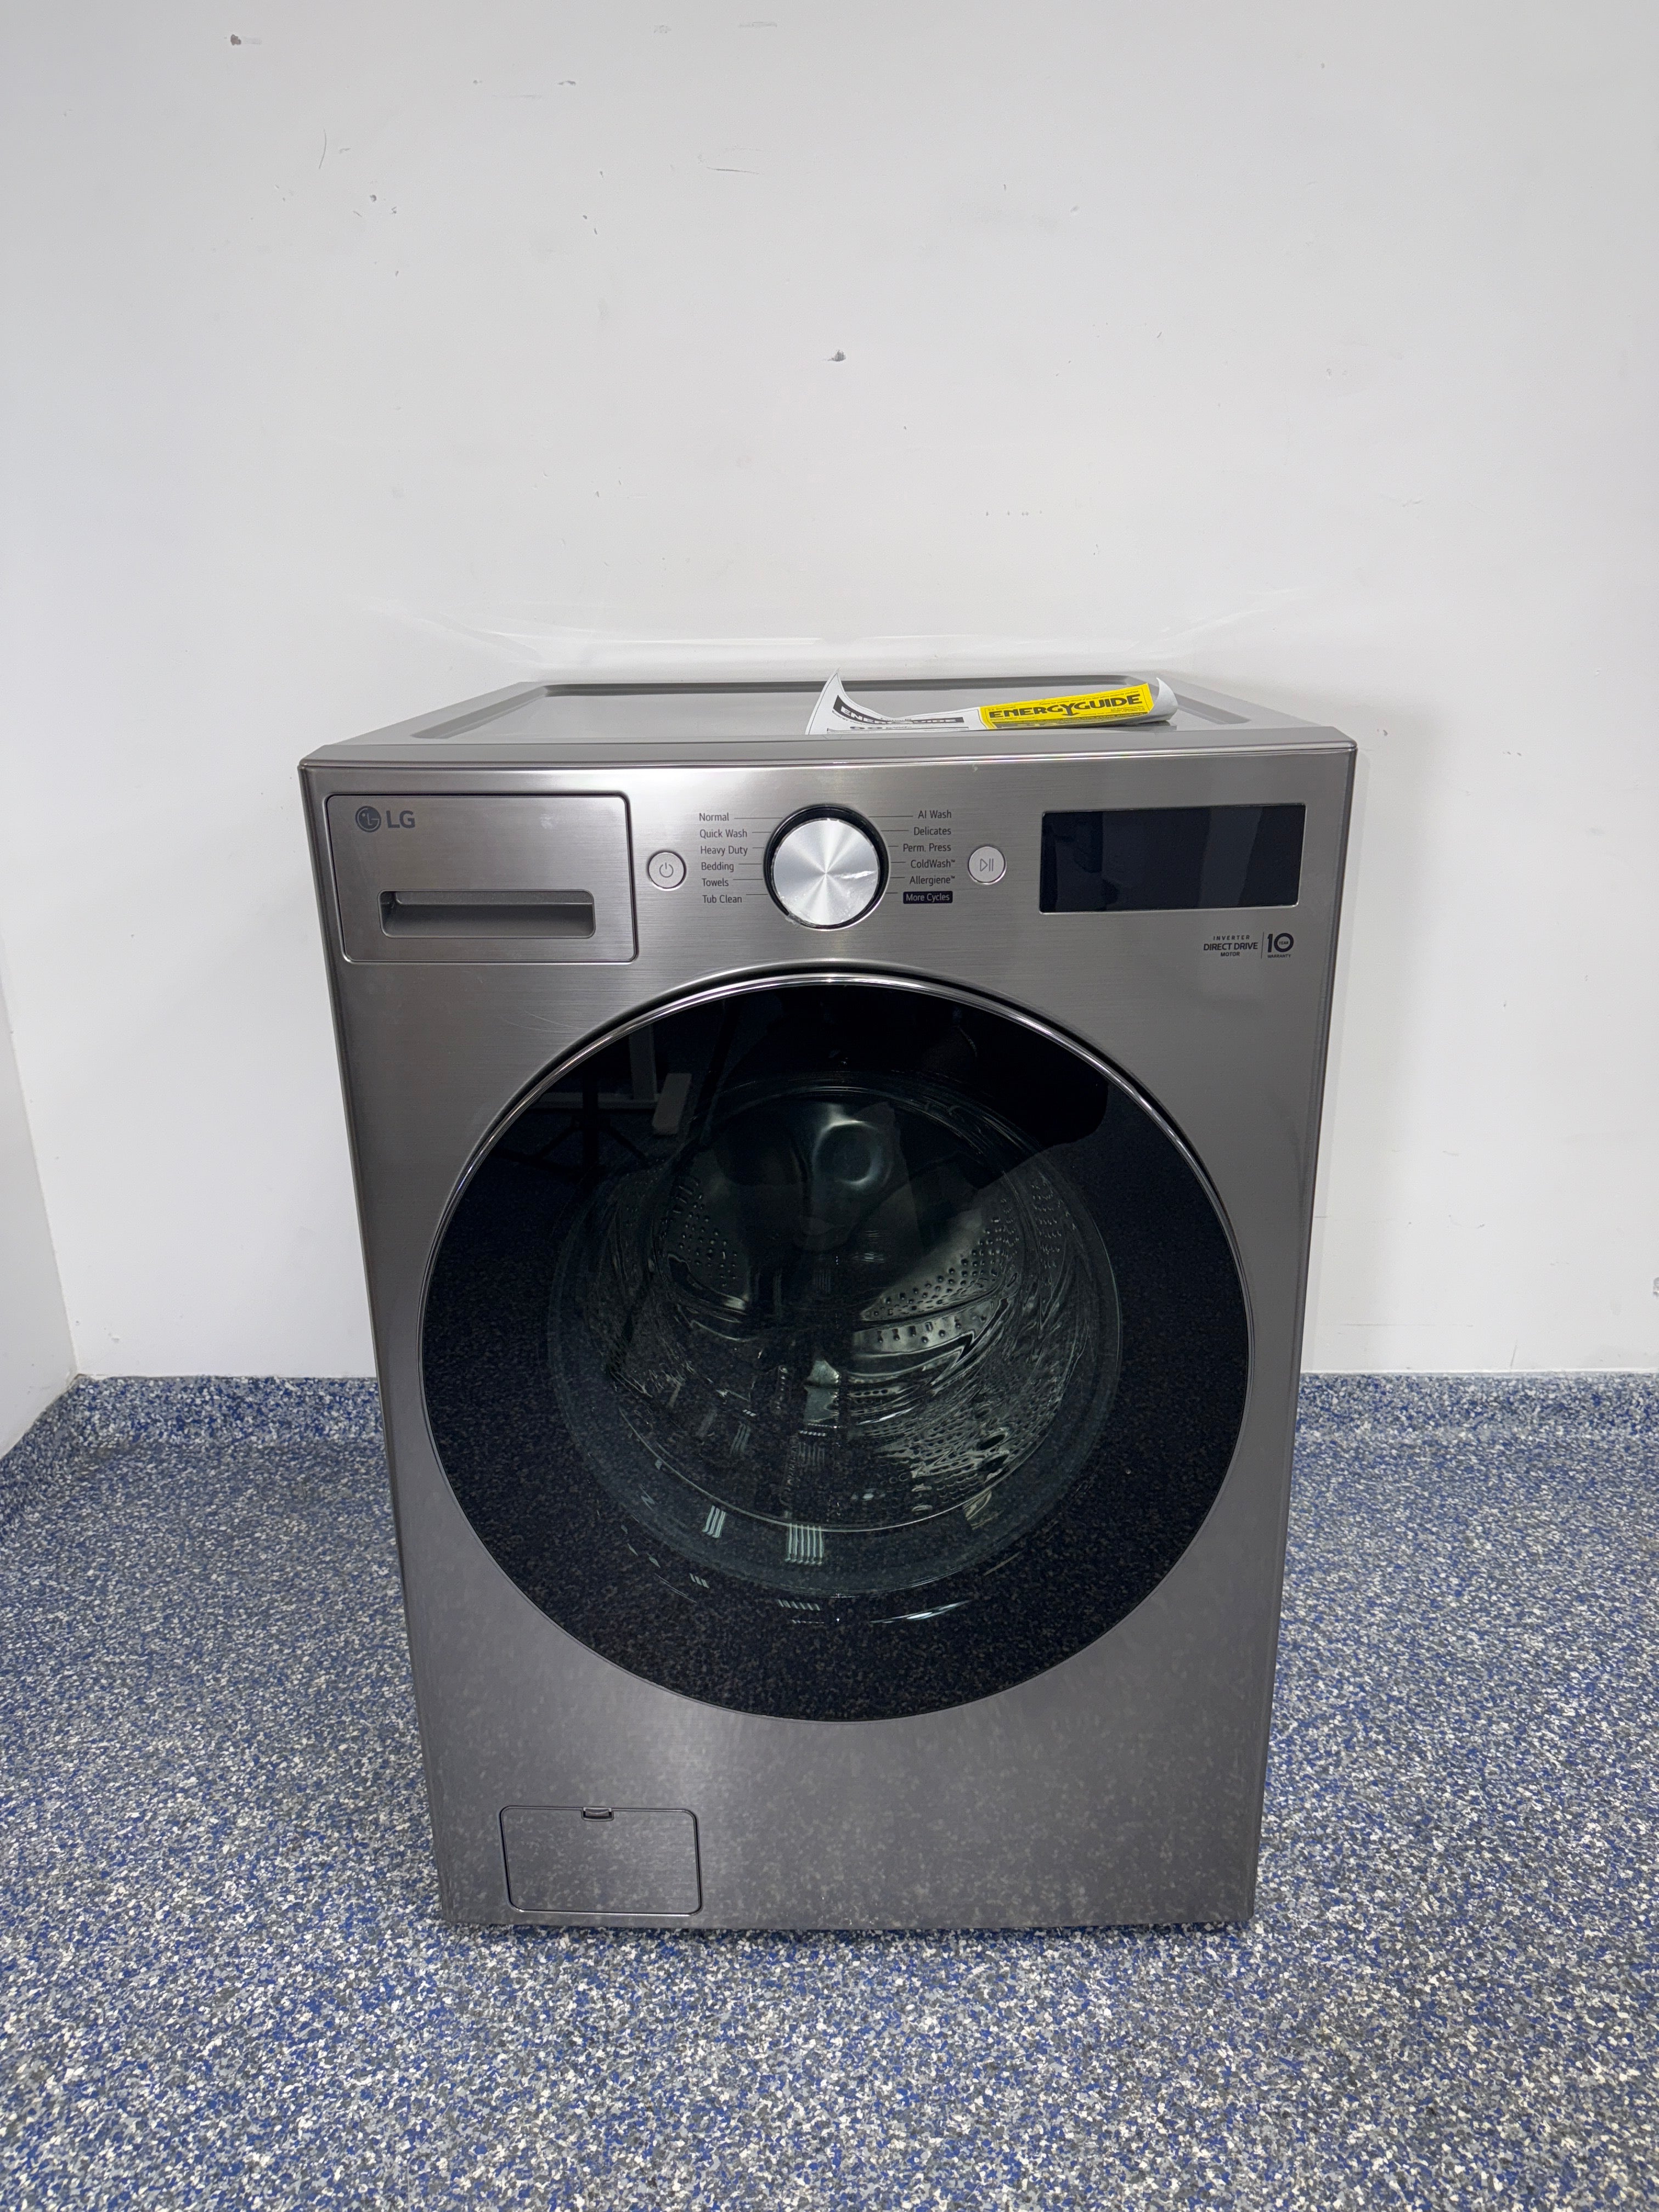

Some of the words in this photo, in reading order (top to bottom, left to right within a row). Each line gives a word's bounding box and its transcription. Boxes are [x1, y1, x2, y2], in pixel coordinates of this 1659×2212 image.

[989, 693, 1143, 716] ENERGYGUIDE
[386, 810, 415, 828] LG
[699, 812, 729, 821] Normal
[918, 810, 927, 819] AI
[929, 809, 952, 819] Wash
[699, 829, 723, 839] Quick
[725, 829, 747, 838] Wash
[913, 826, 951, 836] Delicates
[701, 845, 725, 856] Heavy
[728, 845, 748, 856] Duty
[903, 843, 926, 852] Perm.
[929, 843, 951, 851] Press
[701, 862, 734, 873] Bedding
[702, 878, 729, 887] Towels
[702, 895, 717, 904] Tub
[719, 894, 742, 904] Clean
[927, 893, 950, 902] Cycles
[1267, 933, 1294, 953] 10
